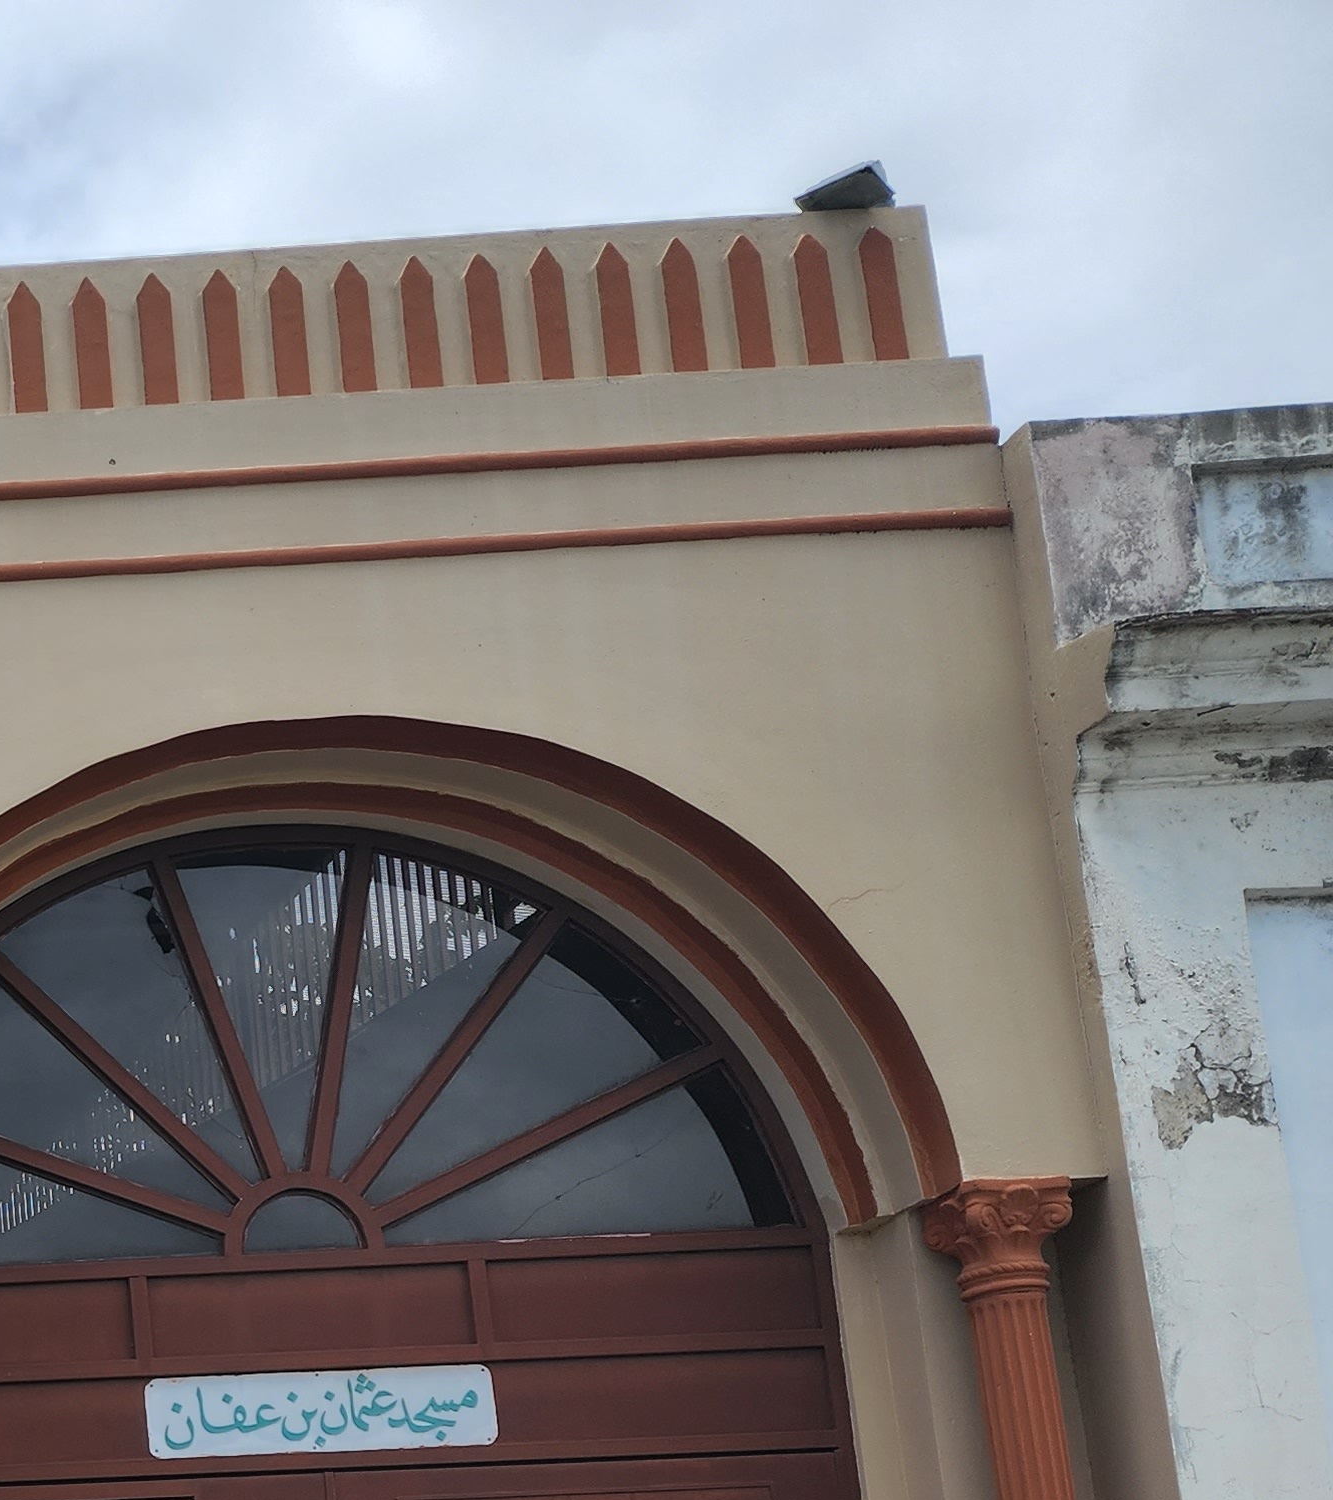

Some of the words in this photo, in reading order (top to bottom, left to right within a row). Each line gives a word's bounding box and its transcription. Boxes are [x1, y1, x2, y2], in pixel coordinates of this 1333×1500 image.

[164, 1386, 282, 1450] عفان
[280, 1391, 326, 1448] بن
[319, 1373, 399, 1437] عثمان
[388, 1388, 479, 1441] مسجد
